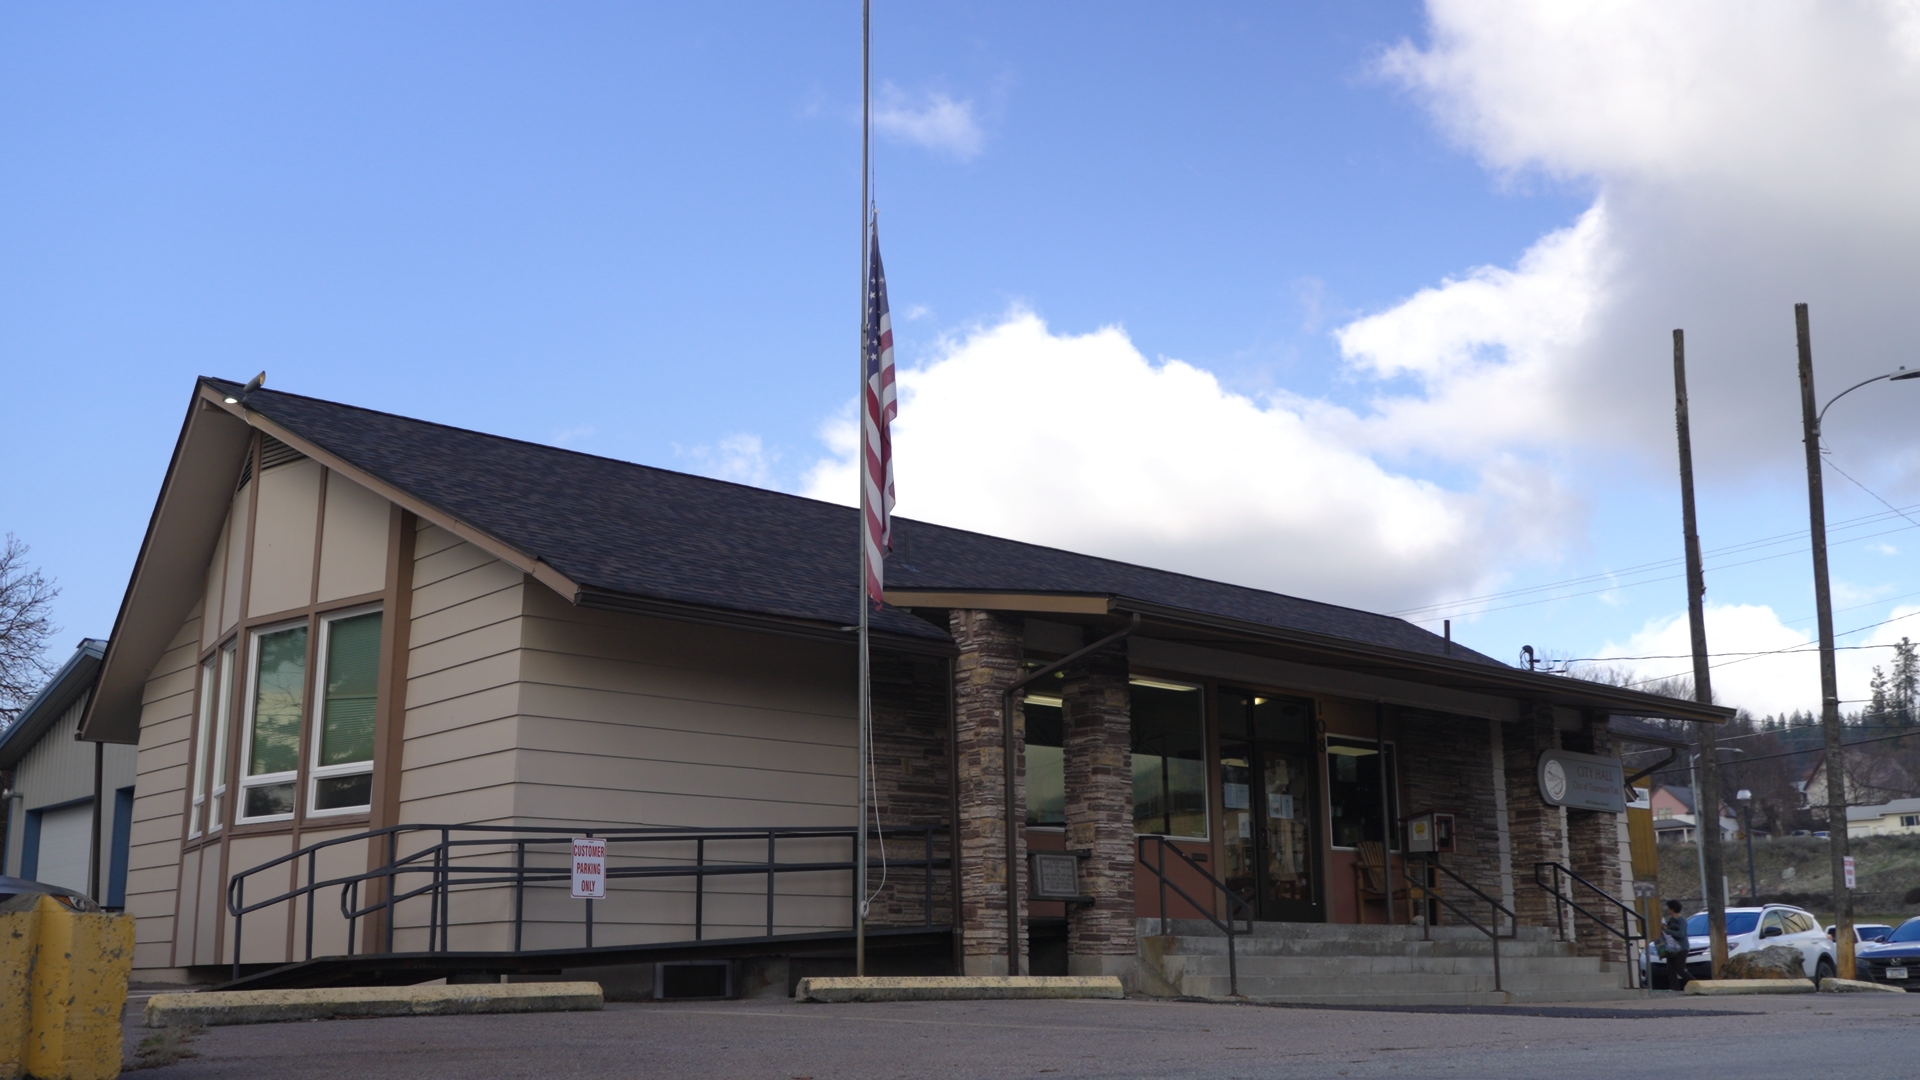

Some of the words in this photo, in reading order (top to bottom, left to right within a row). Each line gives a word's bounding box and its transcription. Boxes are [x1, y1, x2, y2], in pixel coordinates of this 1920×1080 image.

[1317, 700, 1327, 753] 108
[1577, 766, 1593, 778] CITY
[1596, 768, 1613, 782] HALL
[574, 845, 605, 858] CUSTOMER
[577, 862, 601, 875] PARKING
[581, 880, 596, 892] ONLY
